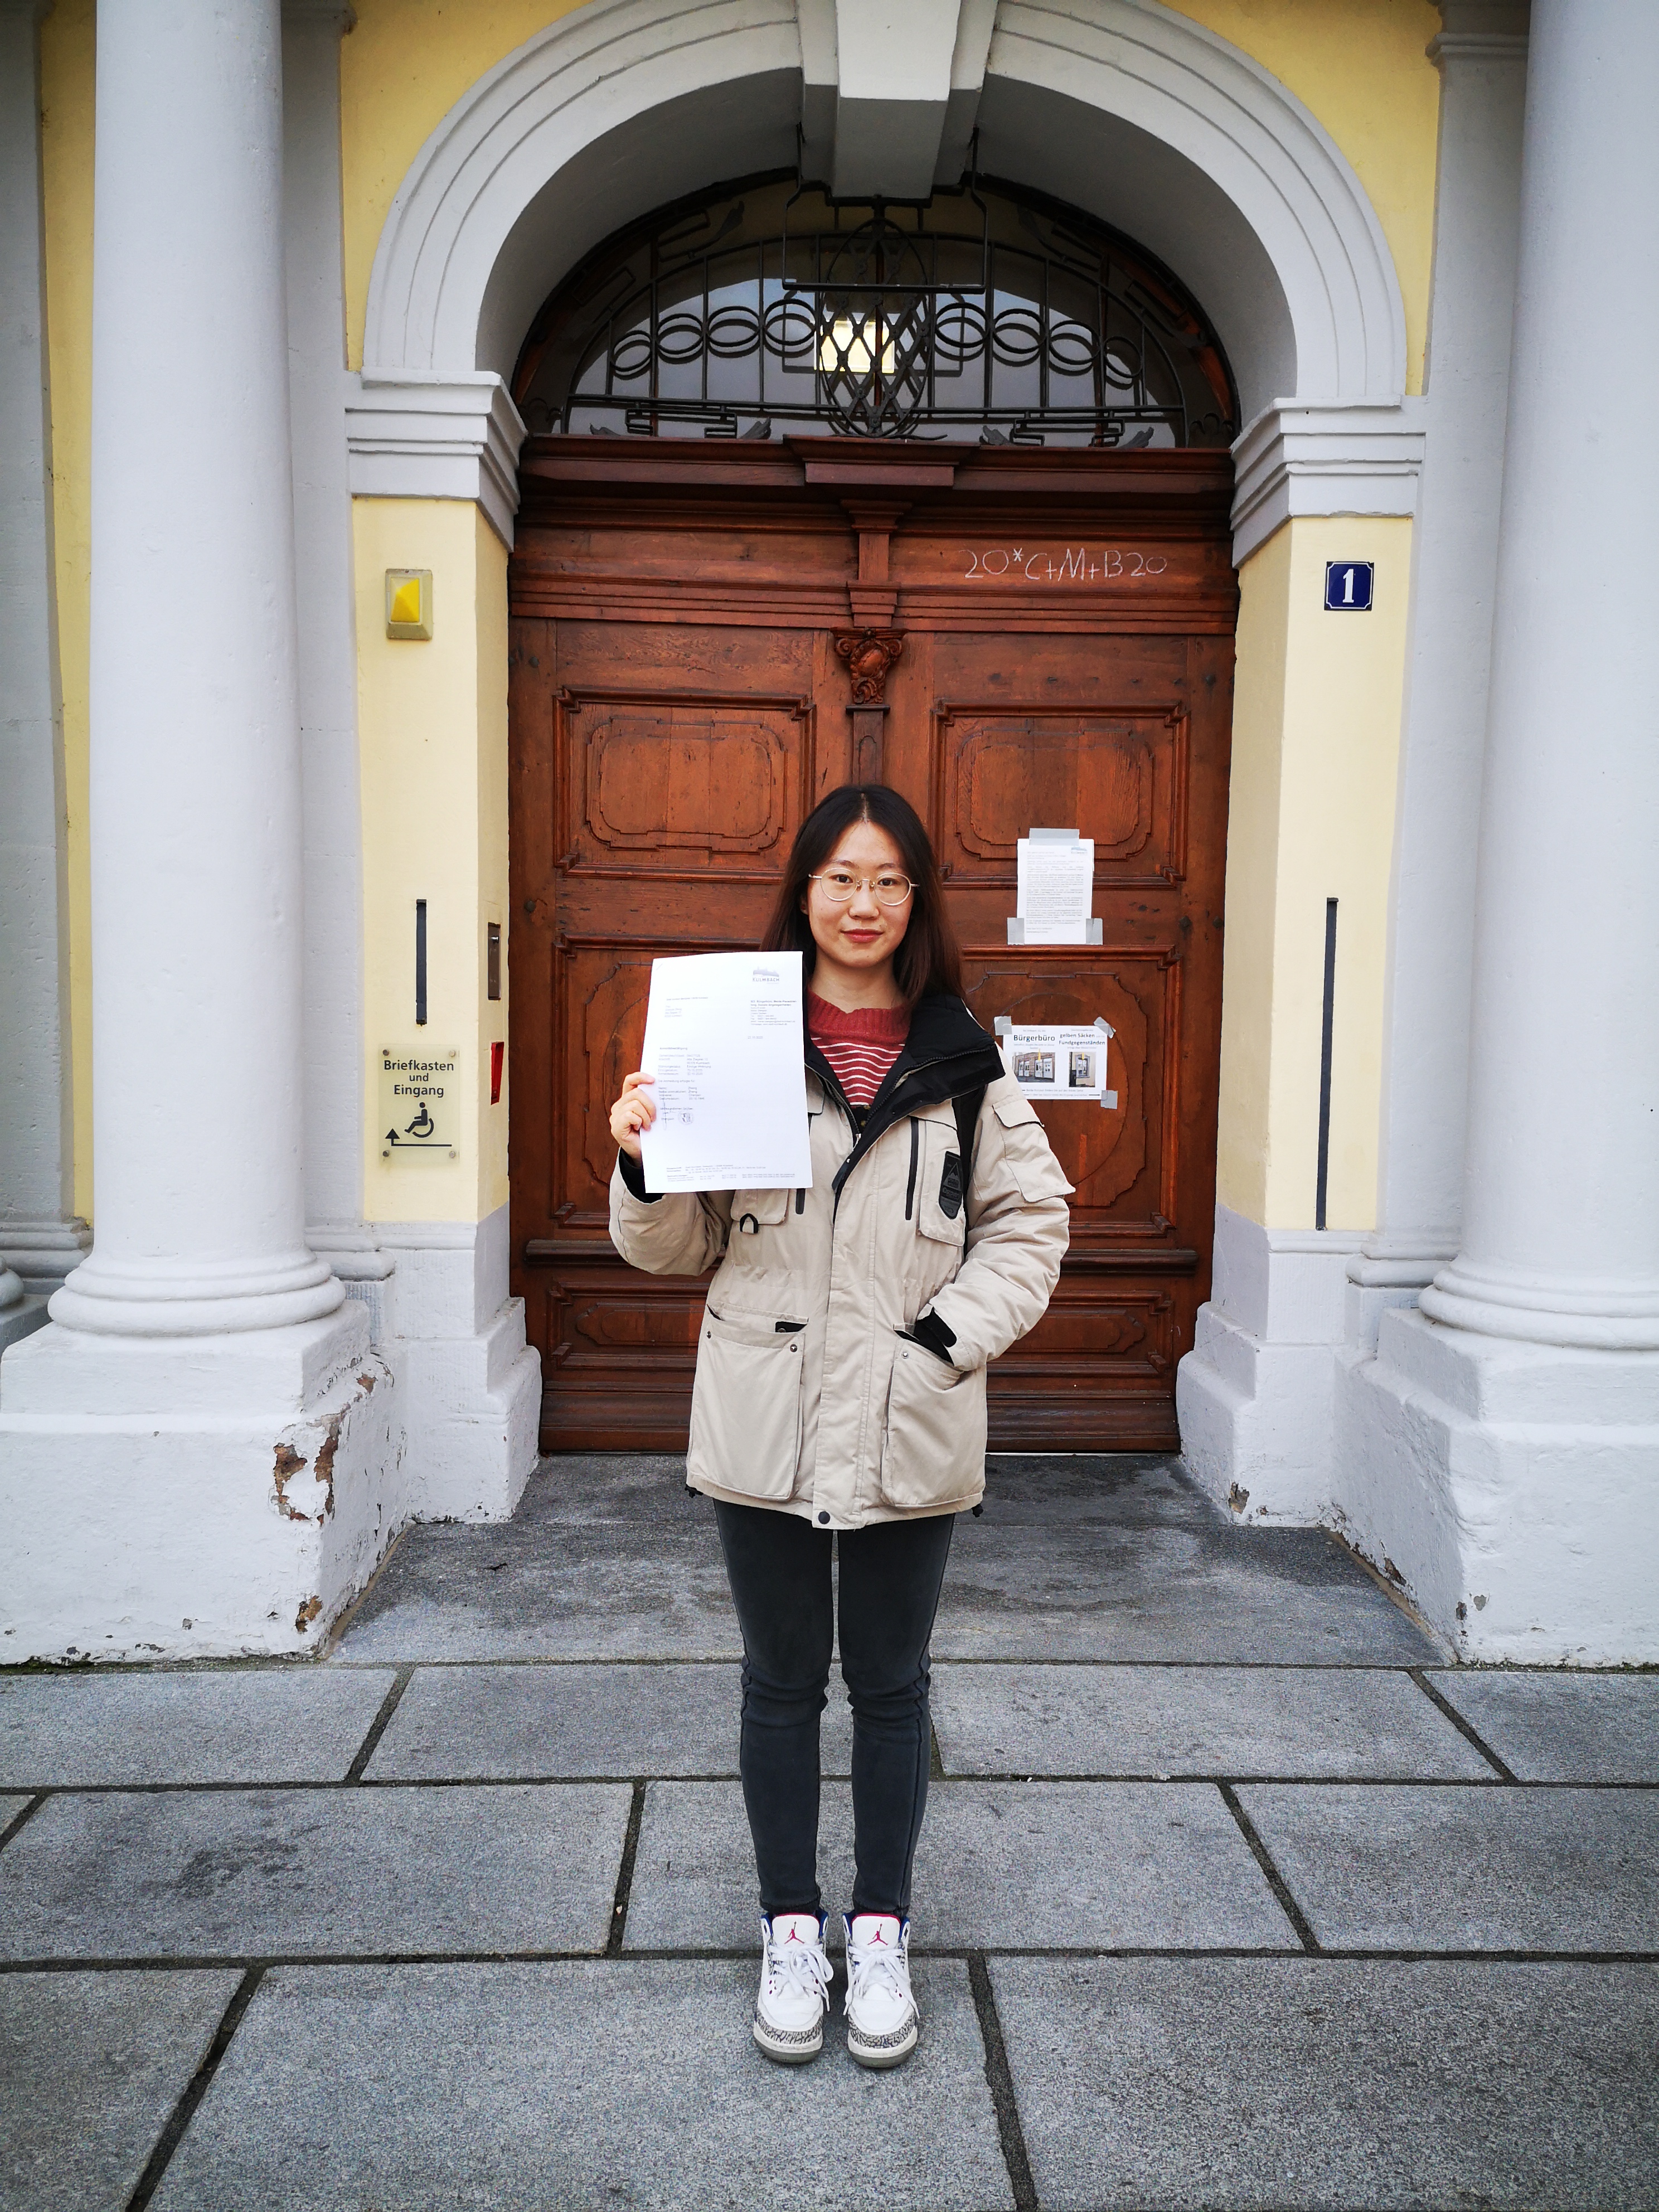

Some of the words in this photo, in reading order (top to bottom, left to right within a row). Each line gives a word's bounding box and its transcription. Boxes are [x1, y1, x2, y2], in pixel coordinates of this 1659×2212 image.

[1342, 569, 1354, 603] 1
[384, 1060, 454, 1071] Briefkasten
[409, 1073, 429, 1081] und
[394, 1084, 444, 1098] Eingang
